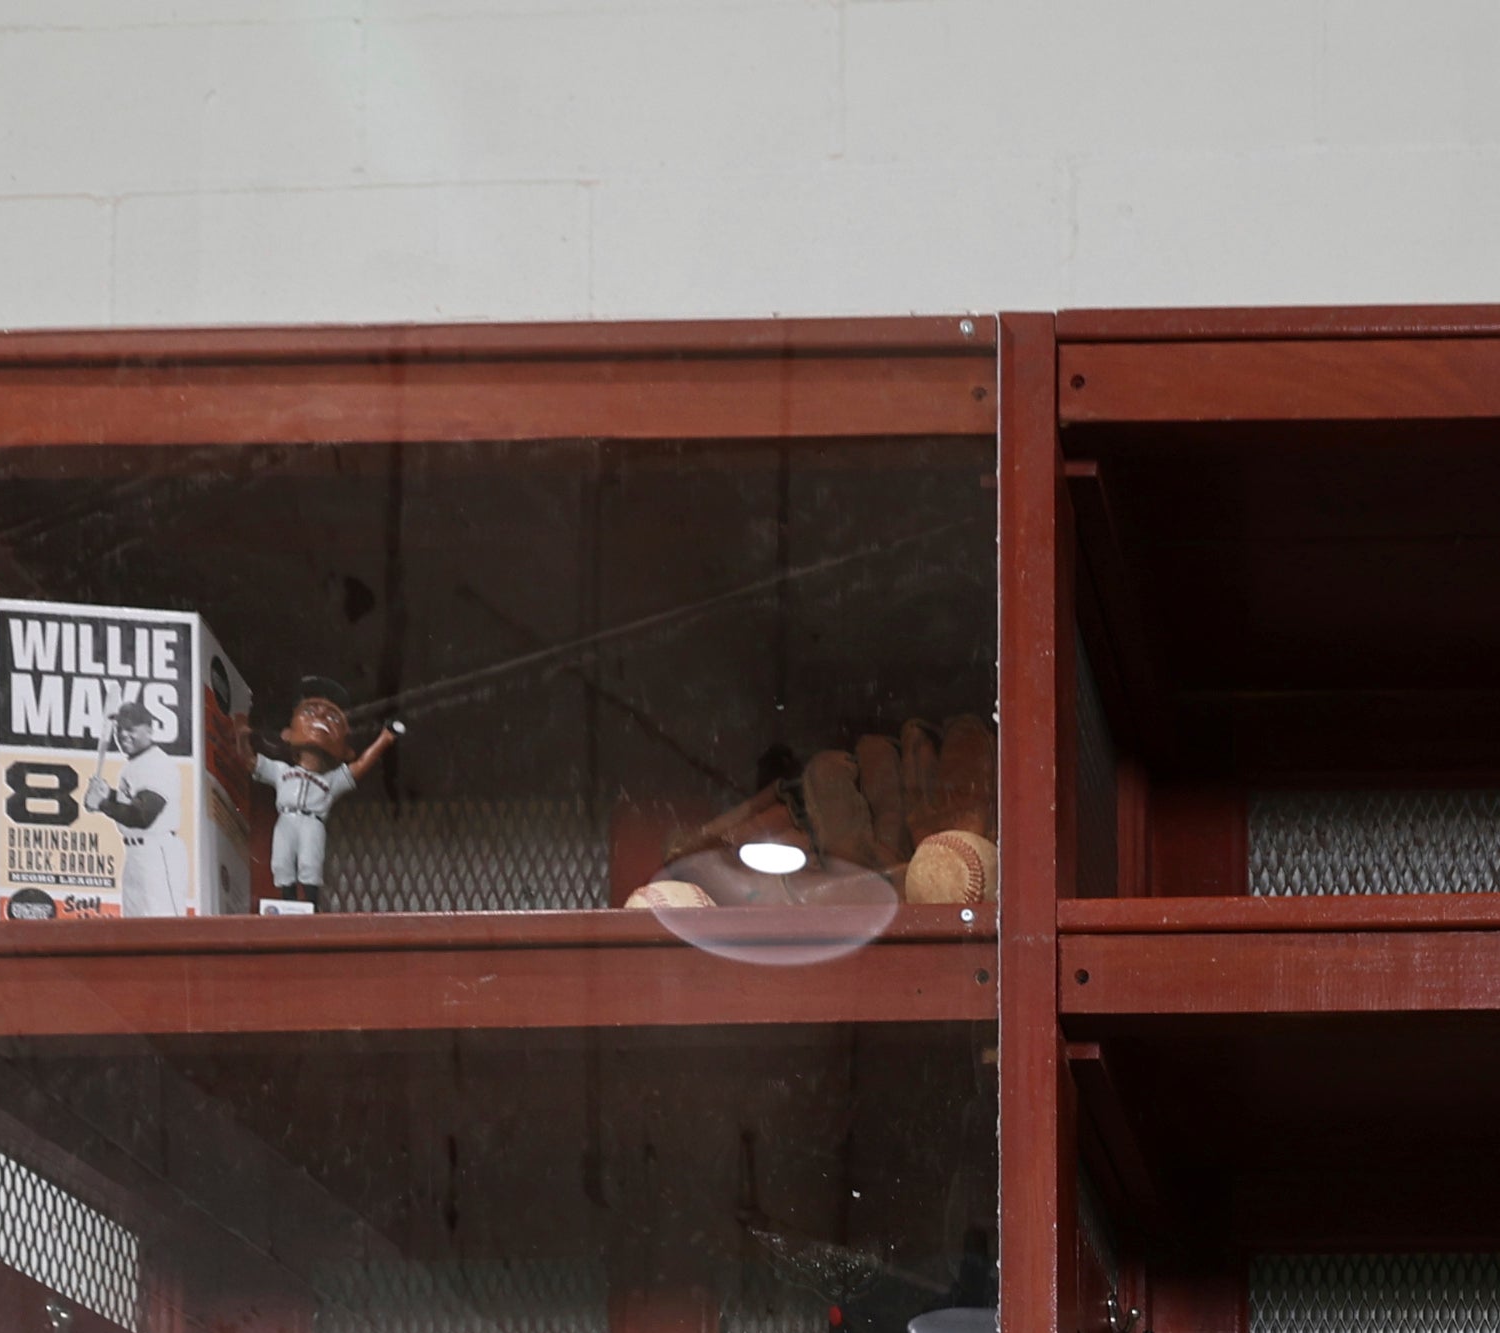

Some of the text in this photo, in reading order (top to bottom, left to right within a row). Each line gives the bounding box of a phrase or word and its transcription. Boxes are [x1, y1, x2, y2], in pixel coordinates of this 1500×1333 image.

[8, 617, 179, 681] WILLIE
[9, 671, 180, 744] MAYS
[4, 760, 80, 827] 8
[7, 826, 100, 853] BIRMINGHAM
[7, 848, 115, 876] BLACK BARONS
[10, 872, 113, 888] NEGRO LEAGUE
